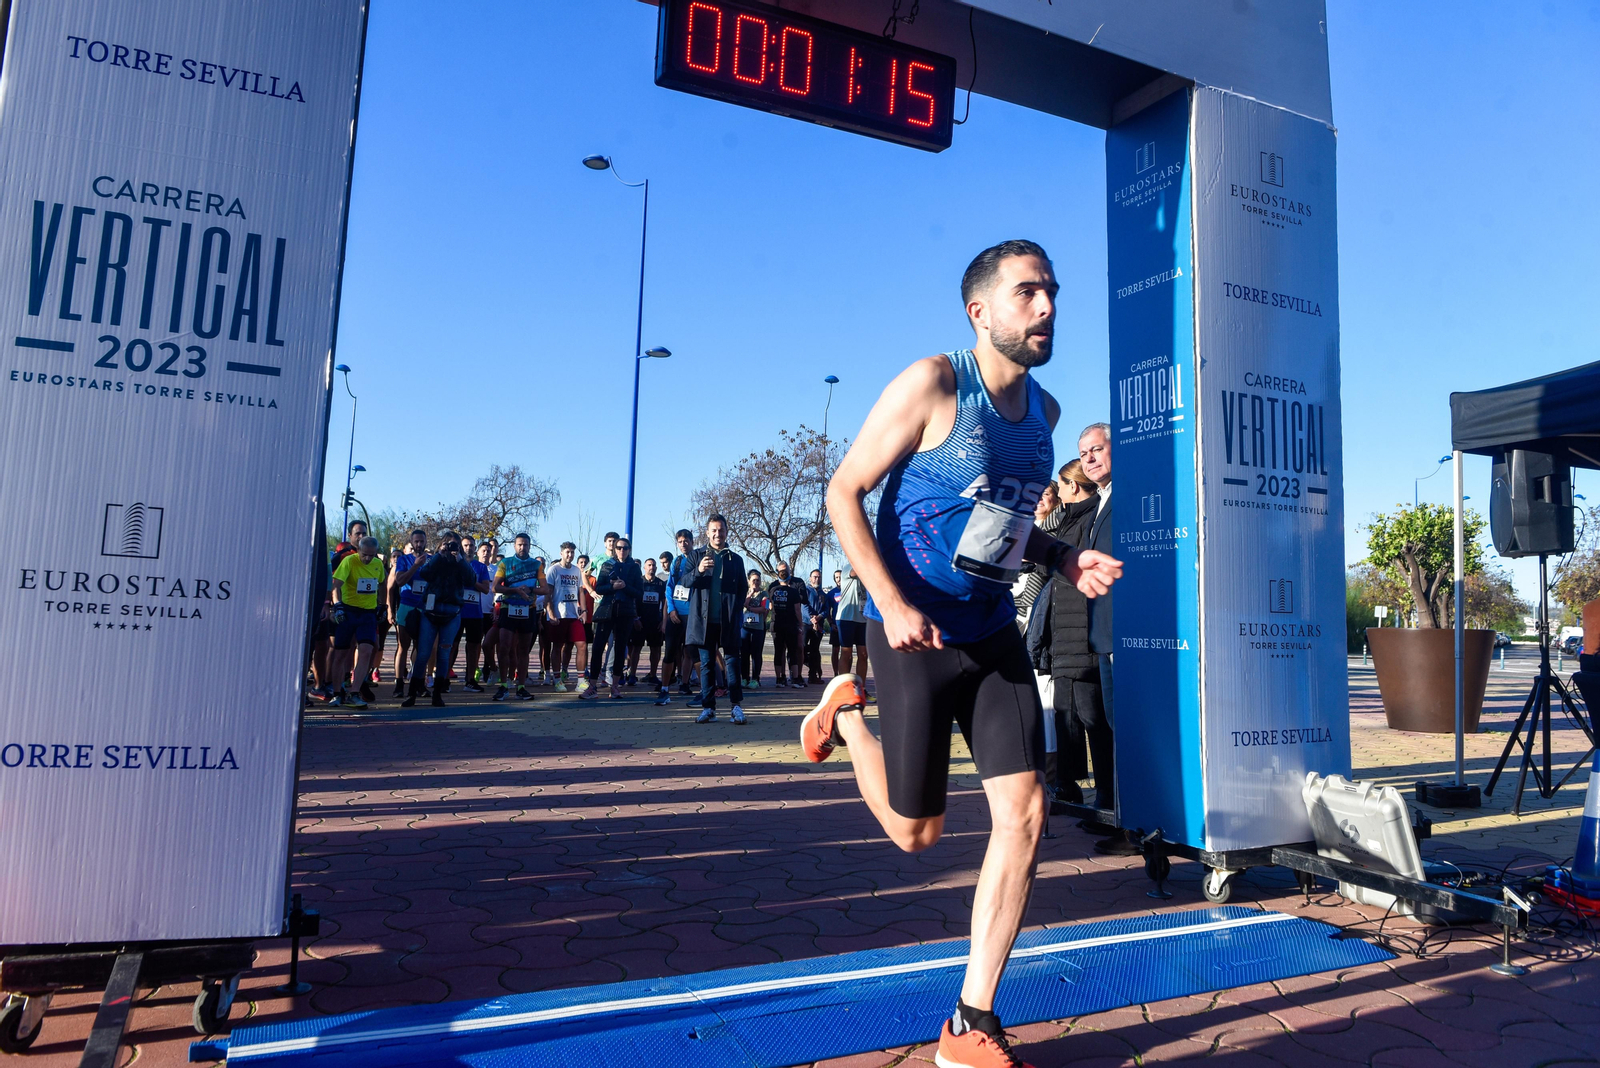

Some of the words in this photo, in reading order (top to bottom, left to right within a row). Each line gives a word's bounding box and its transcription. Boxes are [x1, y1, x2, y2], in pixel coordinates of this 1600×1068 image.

[67, 36, 173, 76] TORRE
[180, 58, 306, 103] SEVILLA
[686, 2, 934, 126] 00:01:15
[1114, 161, 1182, 203] EUROSTARS
[1122, 193, 1143, 208] TORRE
[1145, 180, 1173, 196] SEVILLA
[92, 176, 247, 220] CARRERA
[1230, 183, 1312, 217] EUROSTARS
[1242, 203, 1268, 217] TORRE
[1271, 211, 1303, 227] SEVILLA
[28, 200, 287, 347] VERTICAL
[1116, 280, 1144, 299] TORRE
[1145, 266, 1184, 289] SEVILLA
[1223, 282, 1269, 305] TORRE
[1271, 293, 1323, 317] SEVILLA
[94, 335, 207, 378] 2023
[1130, 354, 1169, 373] CARRERA
[10, 370, 124, 392] EUROSTARS
[134, 383, 195, 400] TORRE
[204, 391, 279, 410] SEVILLA
[1119, 363, 1184, 421] VERTICAL
[1244, 372, 1307, 396] CARRERA
[1120, 435, 1146, 445] EUROSTARS
[1147, 431, 1162, 439] TORRE
[1163, 427, 1185, 436] SEVILLA
[1137, 416, 1165, 433] 2023
[1221, 390, 1328, 476] VERTICAL
[1256, 474, 1301, 499] 2023
[1223, 499, 1271, 511] EUROSTARS
[1274, 503, 1298, 513] TORRE
[1301, 506, 1329, 516] SEVILLA
[1120, 526, 1189, 544] EUROSTARS
[1128, 544, 1149, 553] TORRE
[1150, 542, 1179, 551] SEVILLA
[995, 536, 1018, 564] 7
[19, 568, 232, 600] EUROSTARS
[366, 583, 372, 591] 8
[44, 600, 111, 615] TORRE
[120, 604, 203, 620] SEVILLA
[1121, 637, 1149, 649] TORRE
[1150, 638, 1189, 650] SEVILLA
[1238, 623, 1322, 637] EUROSTARS
[1250, 641, 1277, 650] TORRE
[1281, 641, 1312, 650] SEVILLA
[1231, 730, 1279, 747] TORRE
[1281, 727, 1333, 745] SEVILLA
[0, 743, 94, 769] ORRE
[102, 744, 240, 770] SEVILLA
